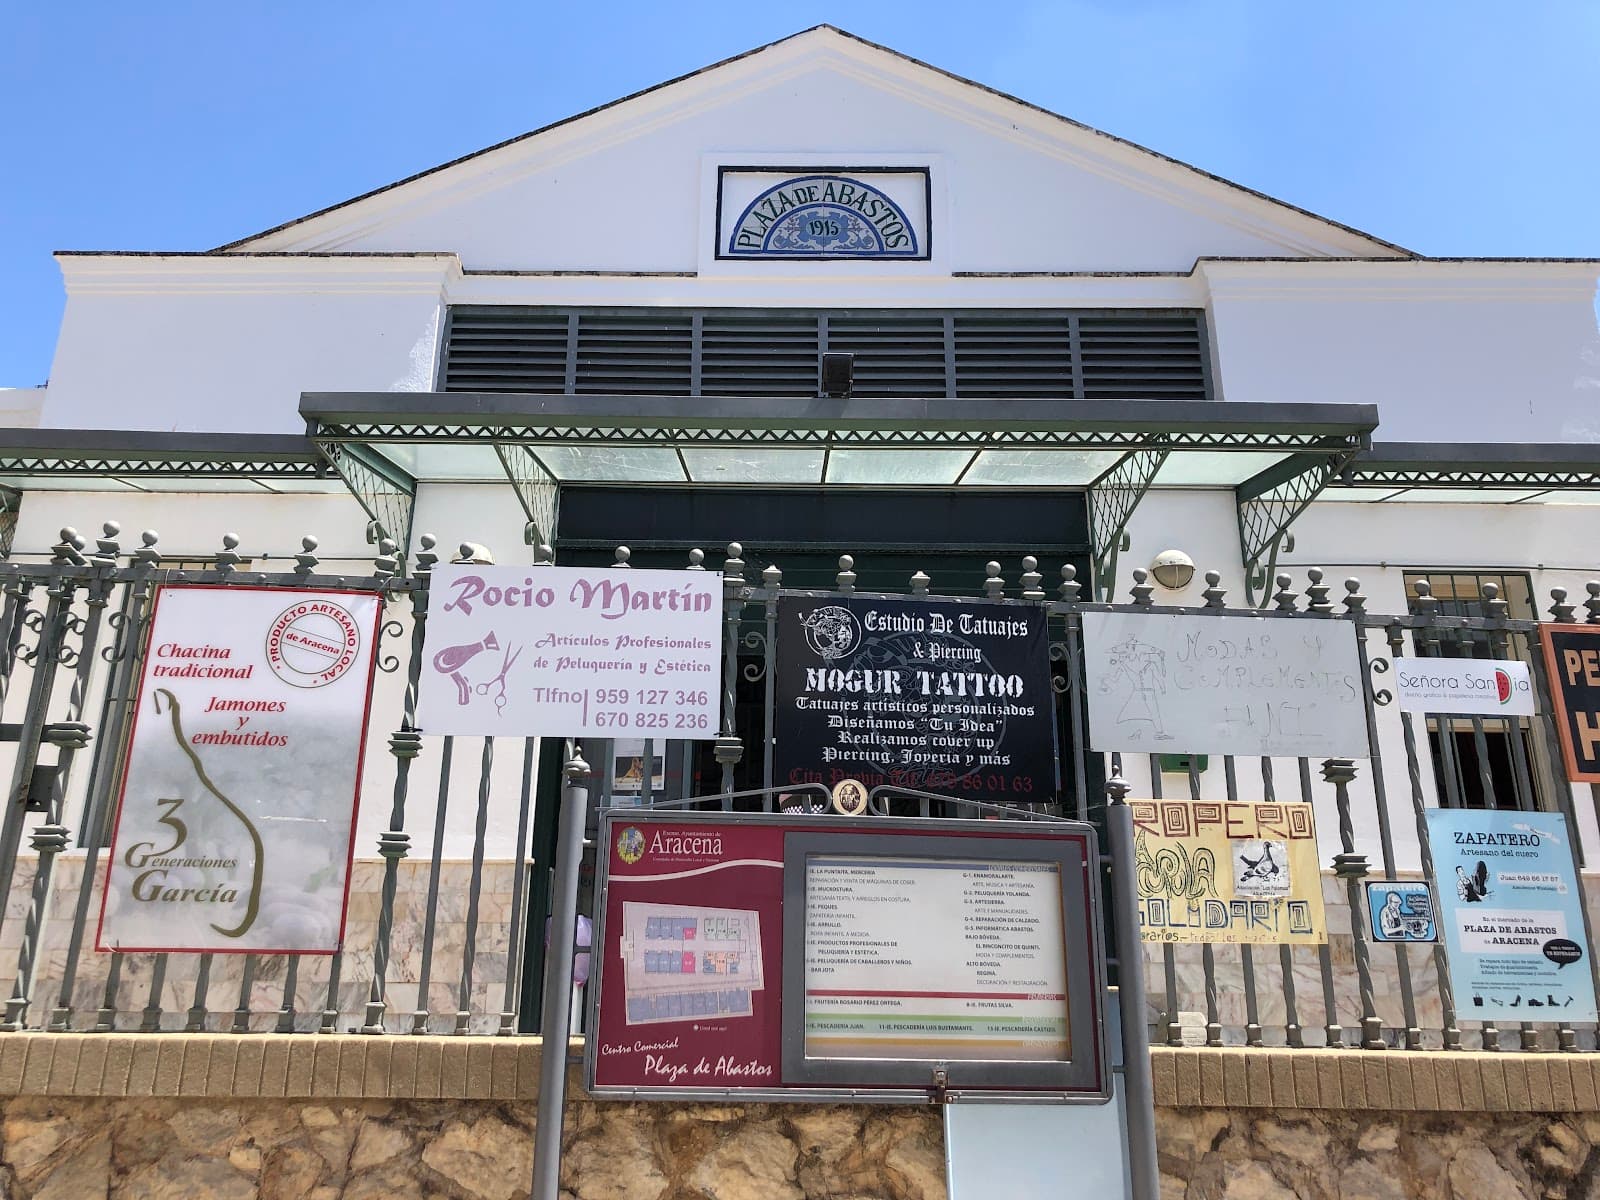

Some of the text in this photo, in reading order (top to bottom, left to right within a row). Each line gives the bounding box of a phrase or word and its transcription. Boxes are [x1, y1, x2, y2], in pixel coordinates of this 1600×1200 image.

[738, 182, 909, 249] PLAZA DE ABASTOS
[809, 220, 839, 237] 1915
[570, 578, 712, 620] Martín
[864, 610, 1028, 640] Estudio De Tatuajes
[270, 604, 356, 681] PRODUCTO ARTESANO LOCAL
[286, 633, 340, 655] de Aracena
[535, 632, 712, 650] Artículos Profesionales
[157, 643, 231, 660] Chacina
[912, 641, 982, 664] & Piercing
[153, 664, 253, 680] tradicional
[534, 656, 712, 676] de Peluquería y Estética
[805, 667, 1025, 699] MOGUR TATTOO
[1399, 671, 1459, 689] Señora
[205, 696, 287, 714] Jamones
[533, 687, 708, 706] Tlfno 959 127 346
[795, 696, 1035, 717] Tatuajes artísticos personalizados
[236, 717, 248, 731] y
[595, 712, 708, 729] 670 825 236
[827, 714, 915, 730] Diseñamos
[192, 731, 289, 747] embutidos
[837, 731, 995, 751] Realizamos cover up
[965, 755, 973, 767] y
[979, 752, 1011, 766] más
[157, 798, 189, 855] 3
[1129, 802, 1314, 840] ROPERO
[649, 830, 723, 855] Aracena
[1454, 831, 1541, 847] ZAPATERO
[125, 842, 239, 870] Generaciones
[1460, 848, 1539, 858] Artesano del cuero
[132, 868, 239, 905] García
[1464, 924, 1557, 935] PLAZA DE ABASTOS
[1492, 937, 1540, 945] ARACENA
[602, 1037, 679, 1056] Centro Comercial
[644, 1054, 773, 1083] Plaza de Abastos
